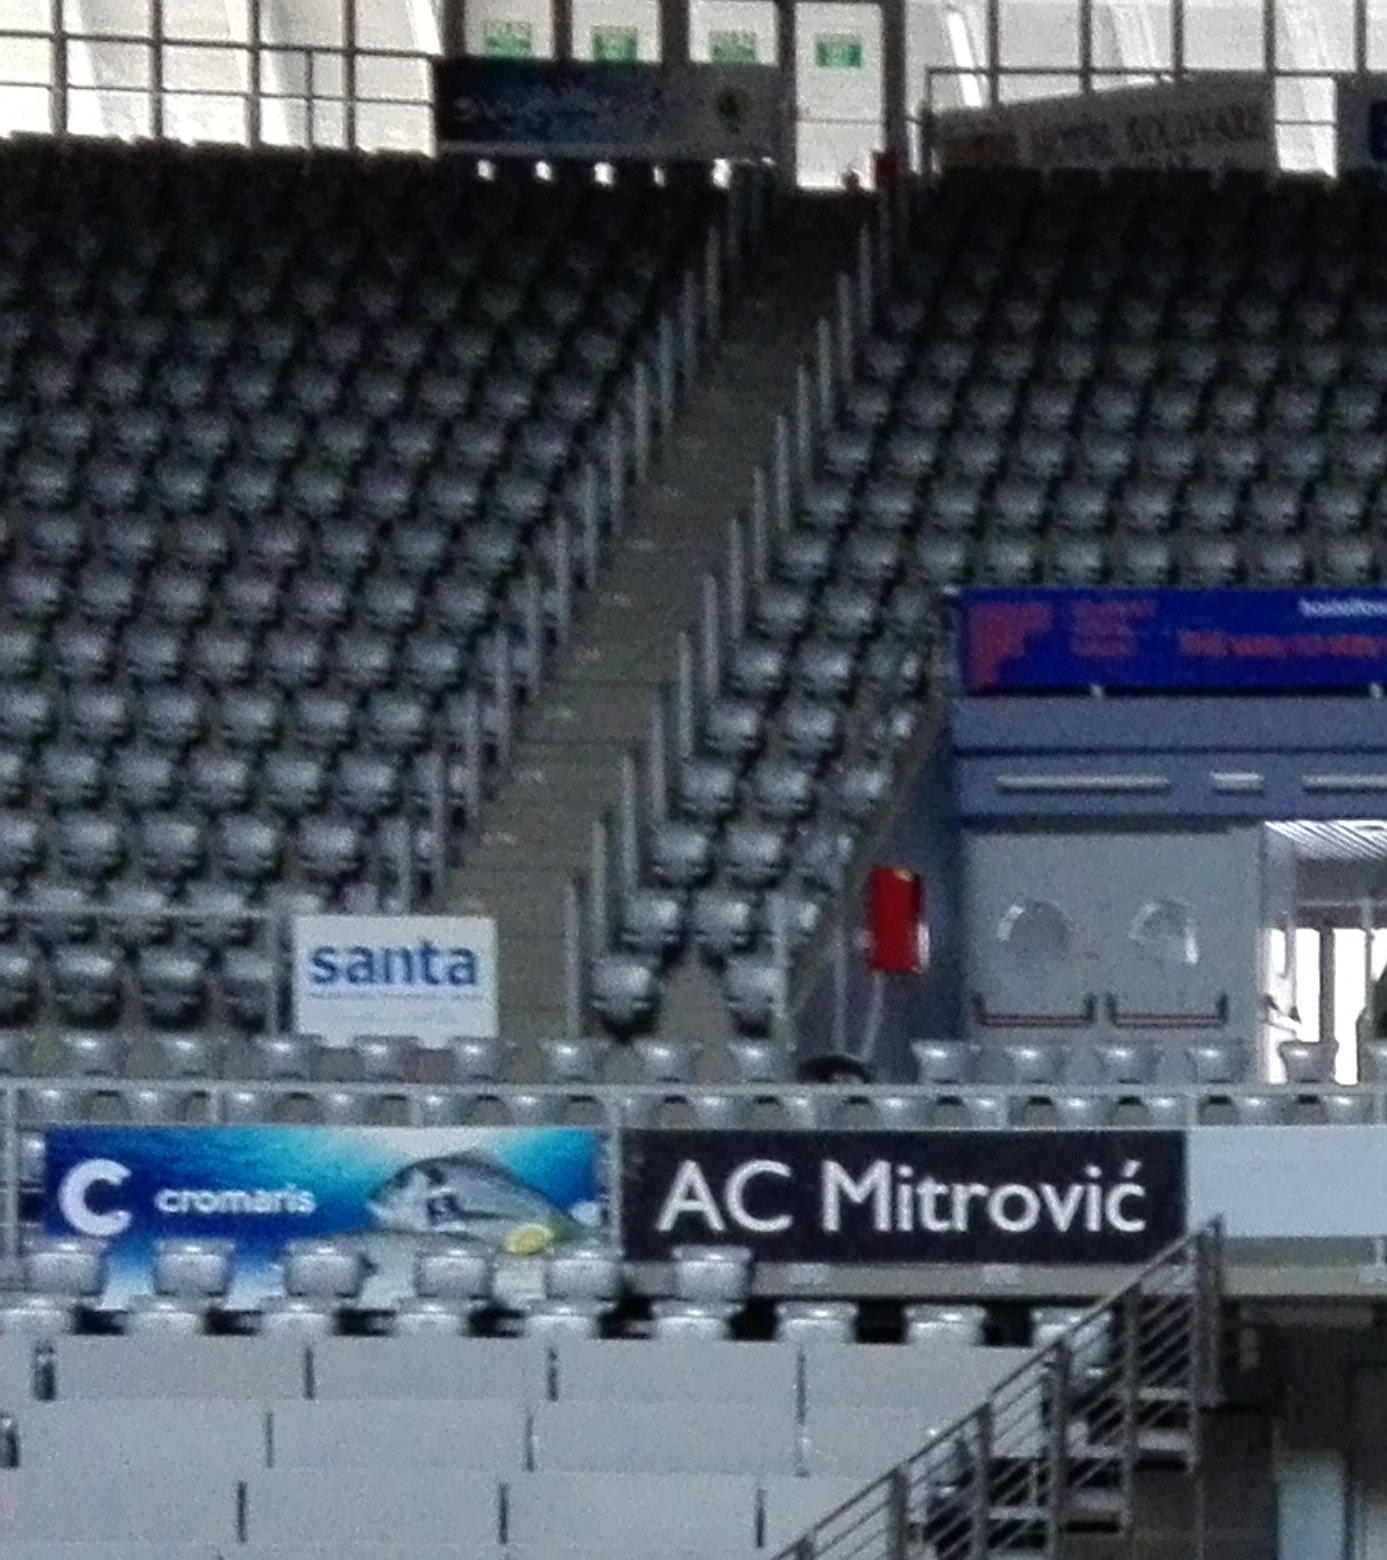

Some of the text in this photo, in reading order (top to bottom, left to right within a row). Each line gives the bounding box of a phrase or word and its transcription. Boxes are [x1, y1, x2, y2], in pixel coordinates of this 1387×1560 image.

[309, 938, 478, 986] santa
[155, 1183, 317, 1215] cromaris
[656, 1158, 1147, 1234] AC Mitrović
